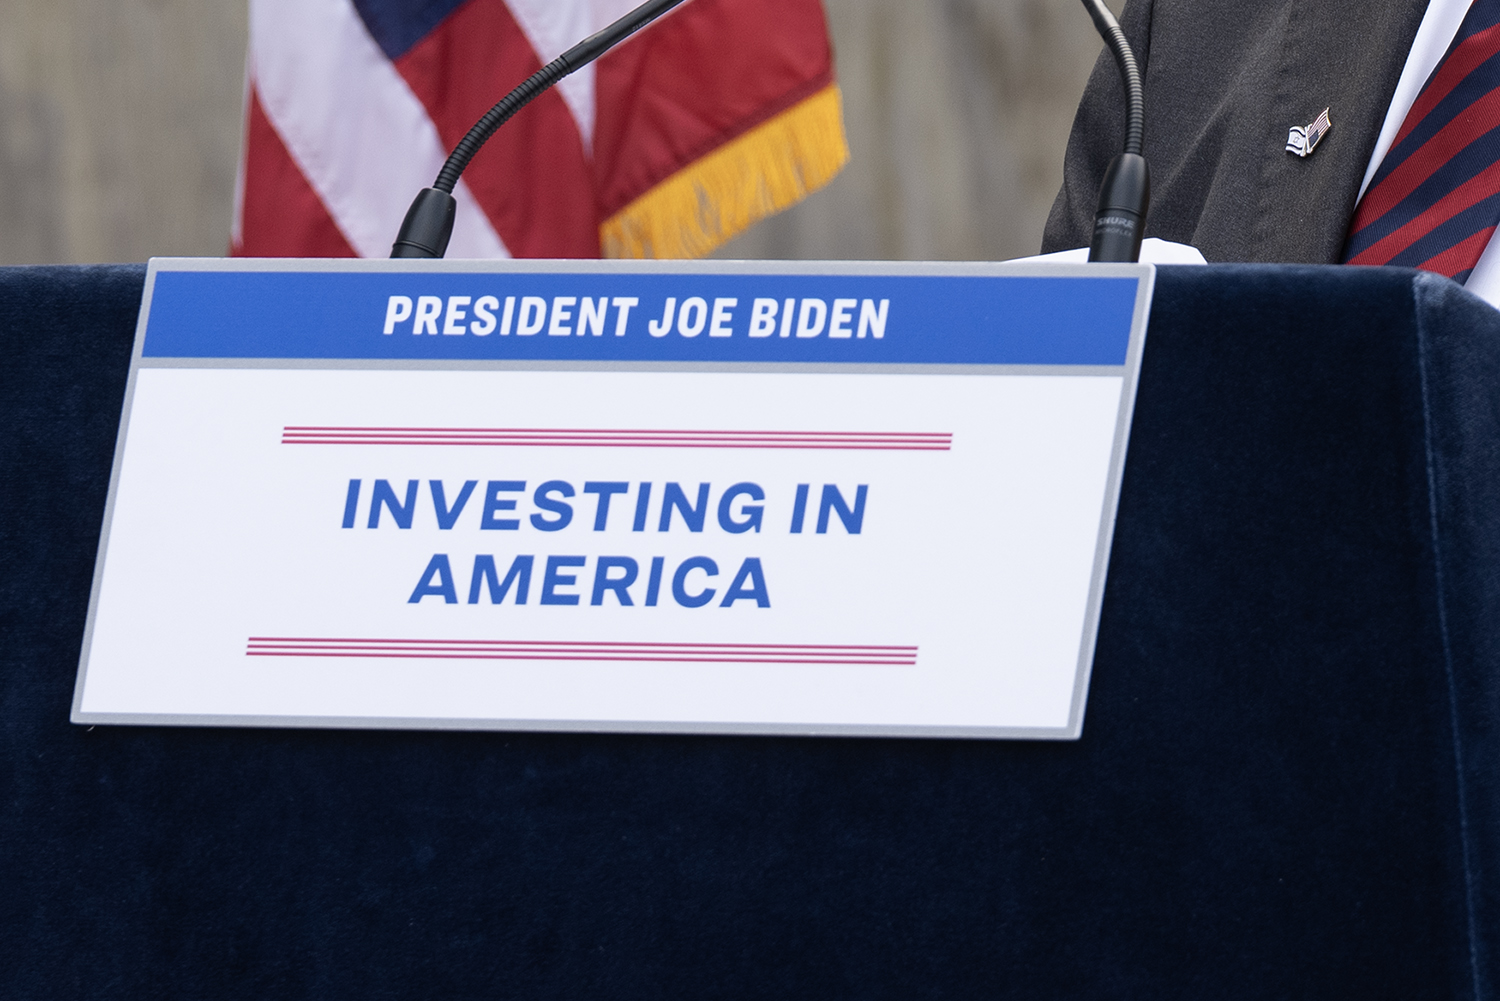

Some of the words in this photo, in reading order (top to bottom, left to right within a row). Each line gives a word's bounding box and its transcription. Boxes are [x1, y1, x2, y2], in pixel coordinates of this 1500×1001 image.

[1095, 227, 1132, 236] ROFLEX
[1096, 216, 1135, 229] SHURE
[383, 295, 639, 337] PRESIDENT
[648, 296, 737, 338] JOE
[748, 297, 890, 339] BIDEN
[341, 479, 765, 535] INVESTING
[789, 483, 869, 535] IN
[407, 553, 772, 609] AMERICA
